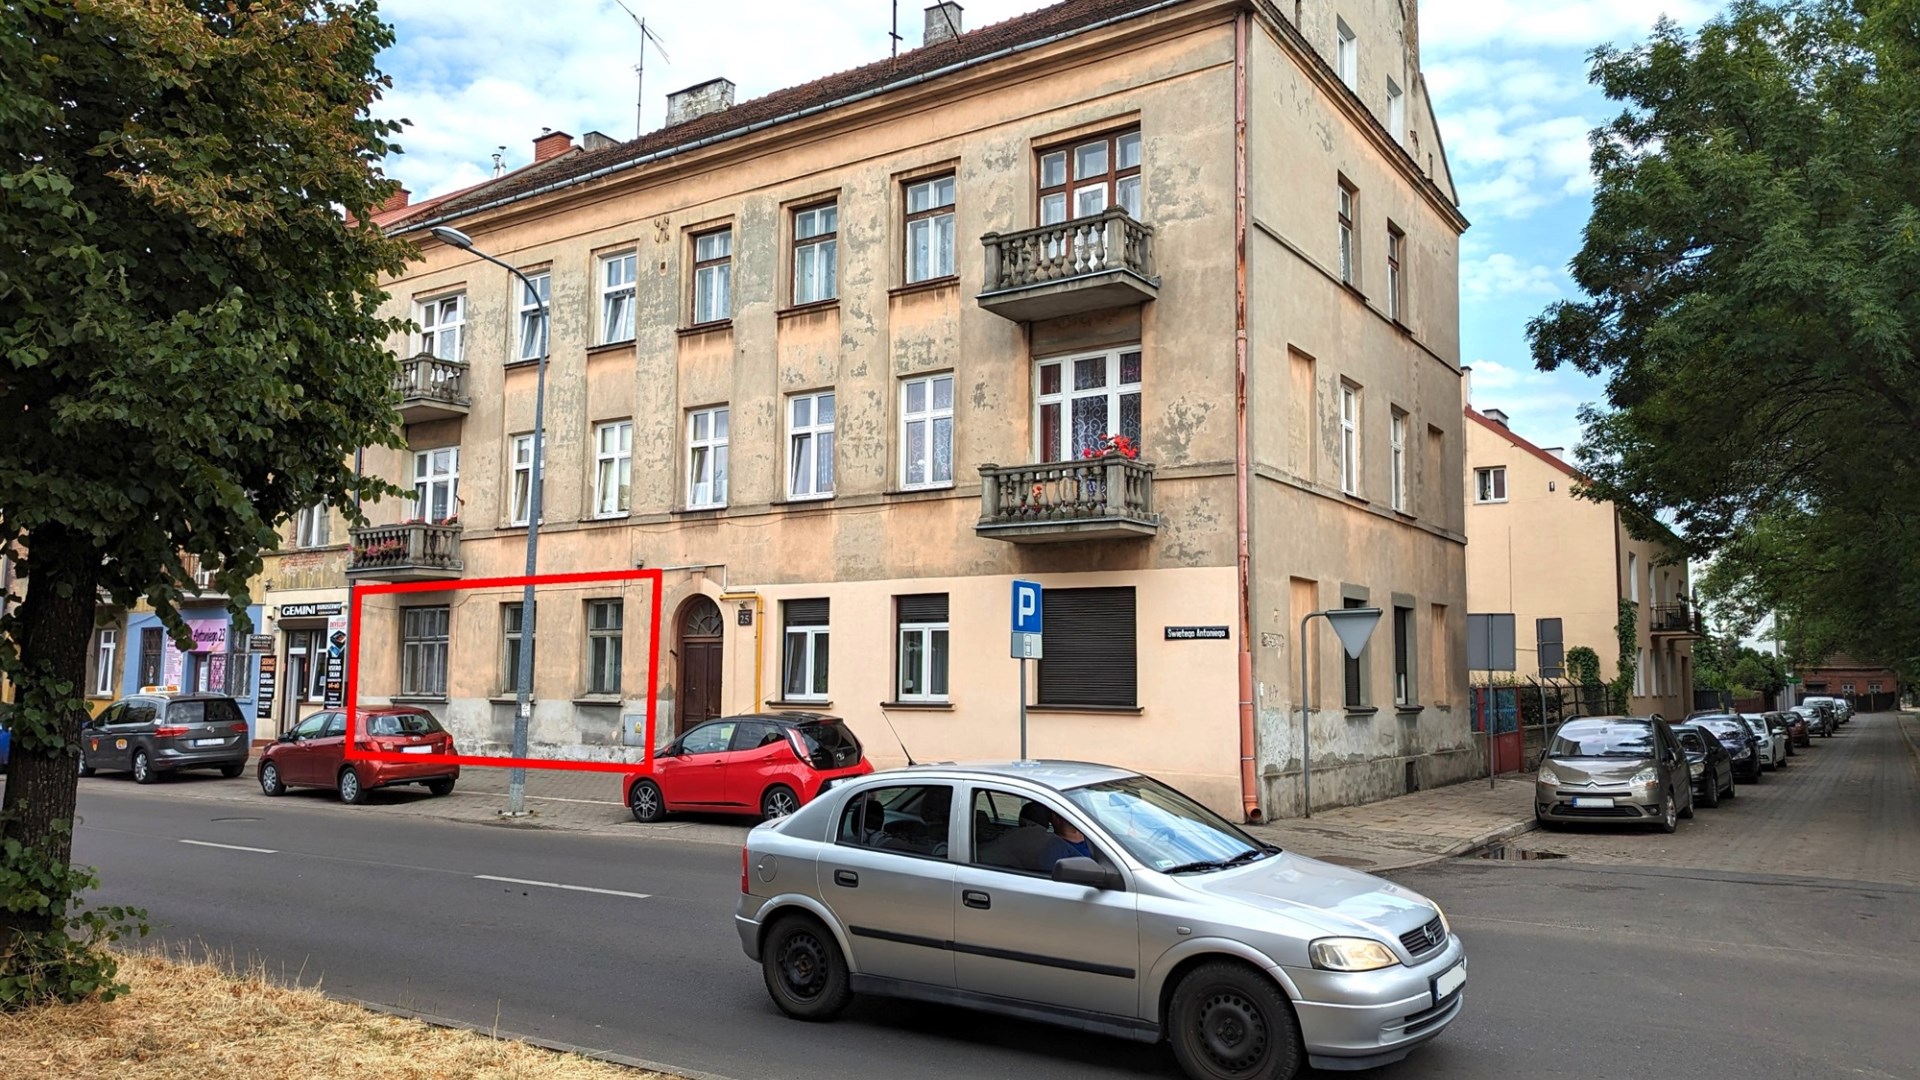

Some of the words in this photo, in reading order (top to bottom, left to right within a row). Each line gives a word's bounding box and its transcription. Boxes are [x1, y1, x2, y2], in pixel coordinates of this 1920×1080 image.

[282, 605, 316, 616] GEMINI
[1018, 586, 1035, 626] P
[740, 614, 750, 624] 25
[1196, 628, 1226, 638] Antoniego
